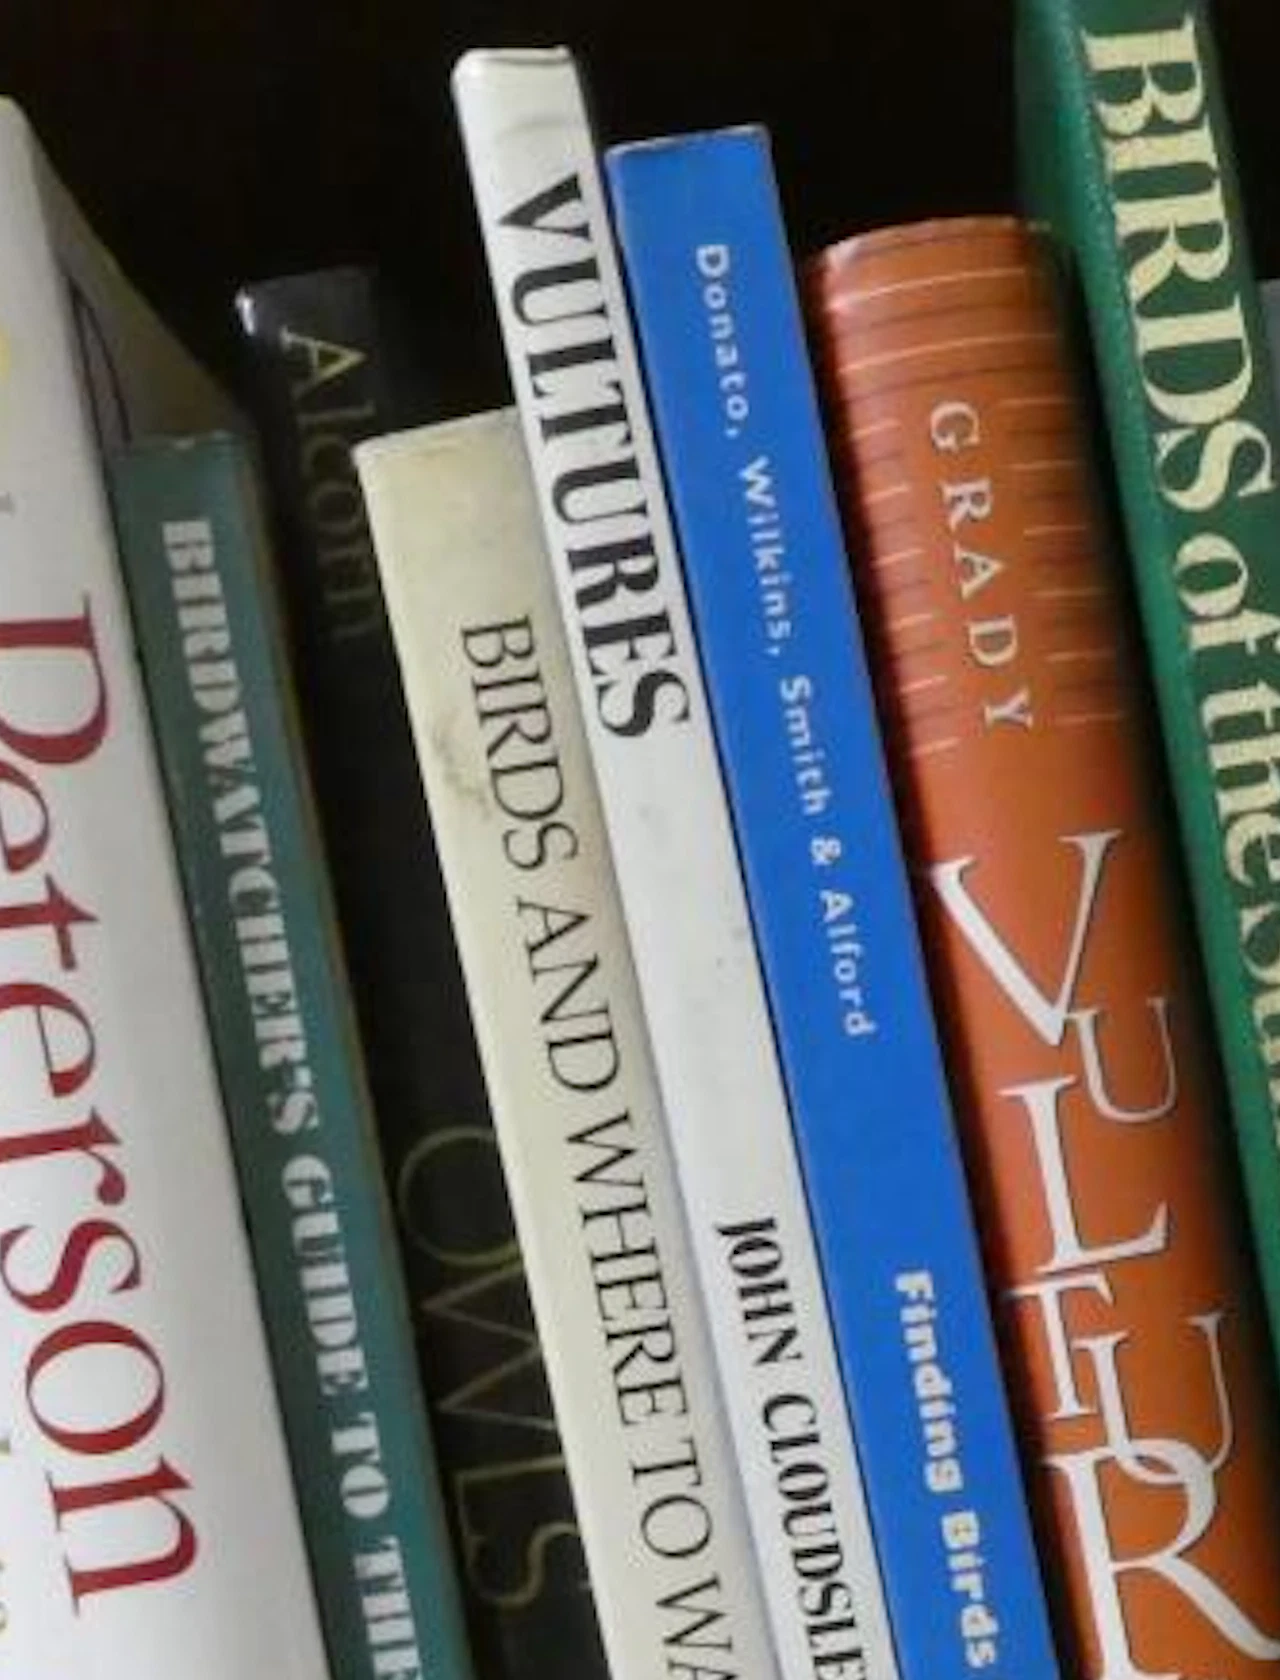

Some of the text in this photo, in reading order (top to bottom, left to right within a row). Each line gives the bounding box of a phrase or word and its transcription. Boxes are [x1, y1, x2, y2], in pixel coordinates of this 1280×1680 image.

[1080, 15, 1277, 513] BIRDS
[496, 173, 690, 740] VULTURES
[929, 401, 1034, 730] GRADY
[460, 614, 580, 871] BIRDS
[694, 243, 877, 1038] Donato, Wilkins, Smith & Alford
[162, 519, 319, 1135] BIRDWATCHER'S
[280, 1154, 368, 1396] GUIDE
[331, 1411, 391, 1519] TO
[517, 895, 619, 1092] AND
[565, 1111, 690, 1427] WHERE
[714, 1217, 803, 1366] JOHN
[630, 1438, 714, 1560] TO
[894, 1269, 966, 1494] Finding
[941, 1511, 1000, 1669] Birds
